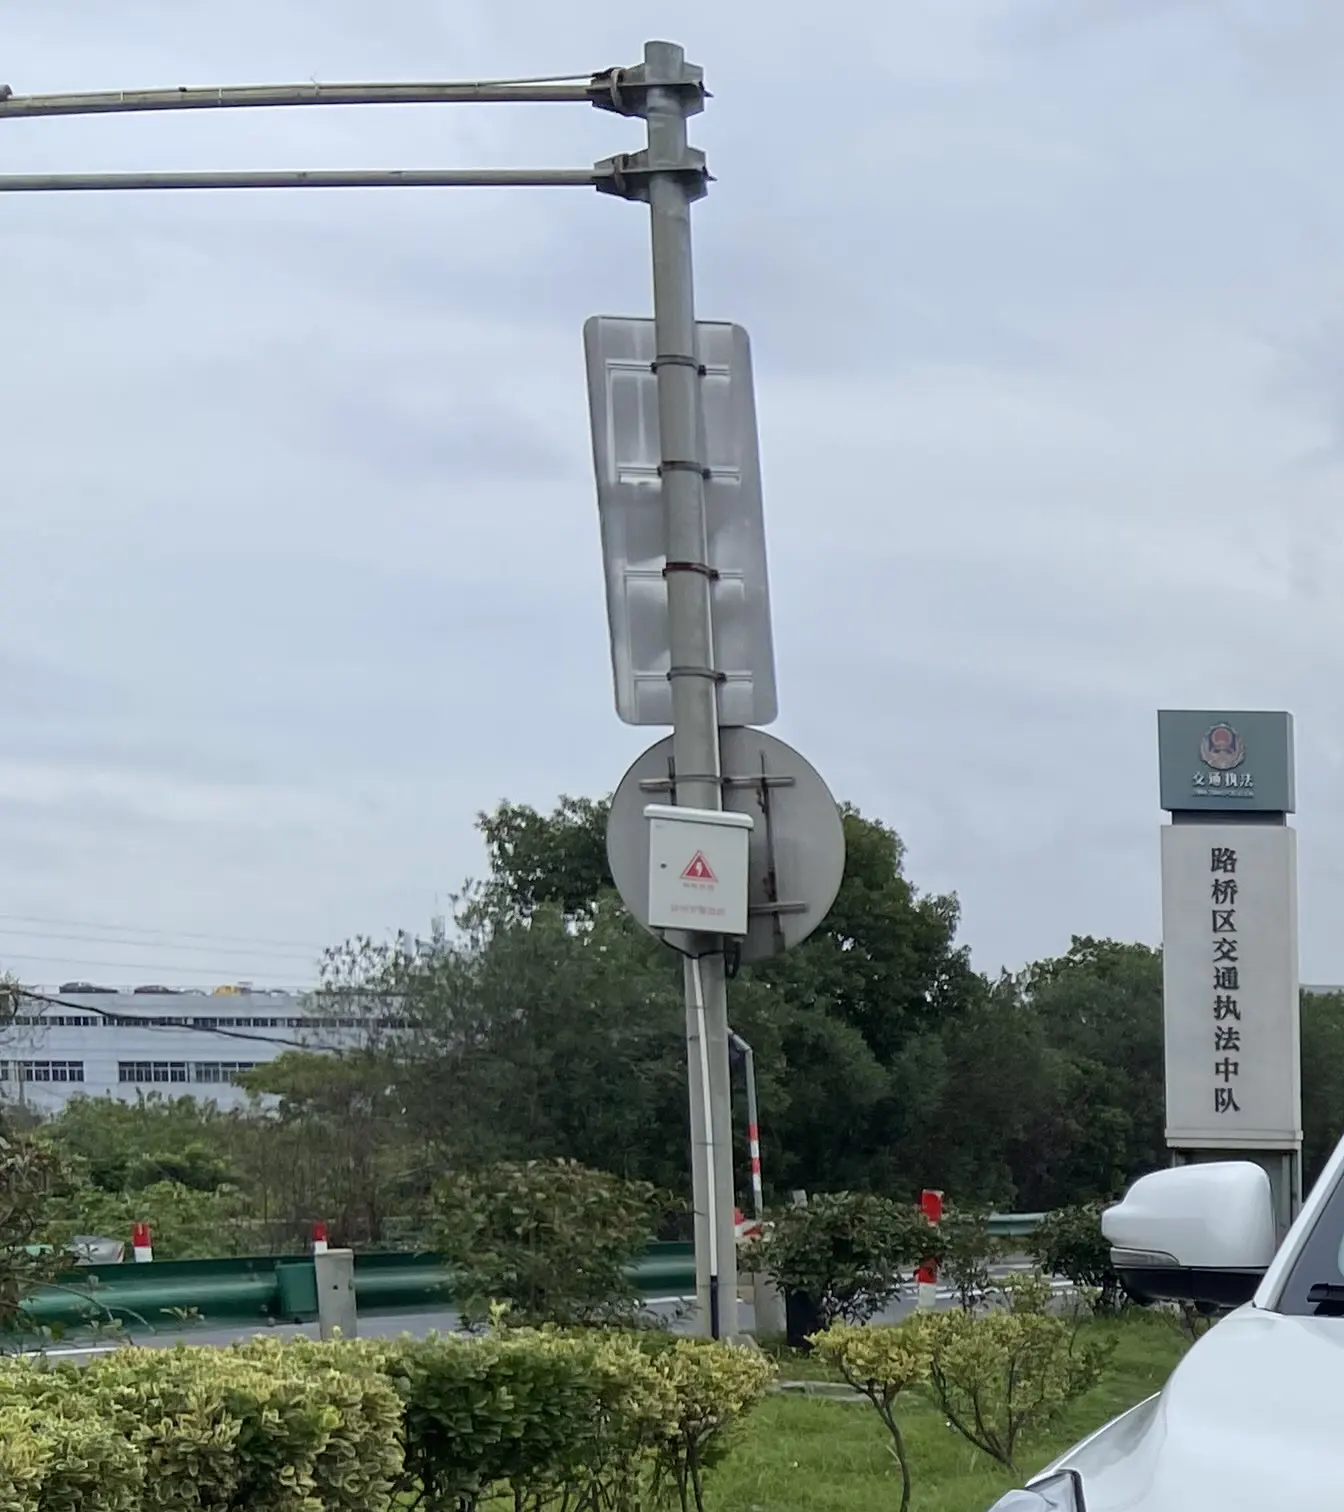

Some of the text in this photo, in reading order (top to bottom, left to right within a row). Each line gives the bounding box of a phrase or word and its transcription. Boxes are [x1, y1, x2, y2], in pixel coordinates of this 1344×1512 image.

[1192, 771, 1253, 788] 交通执法
[1211, 848, 1240, 1113] 路桥区交通执法中队
